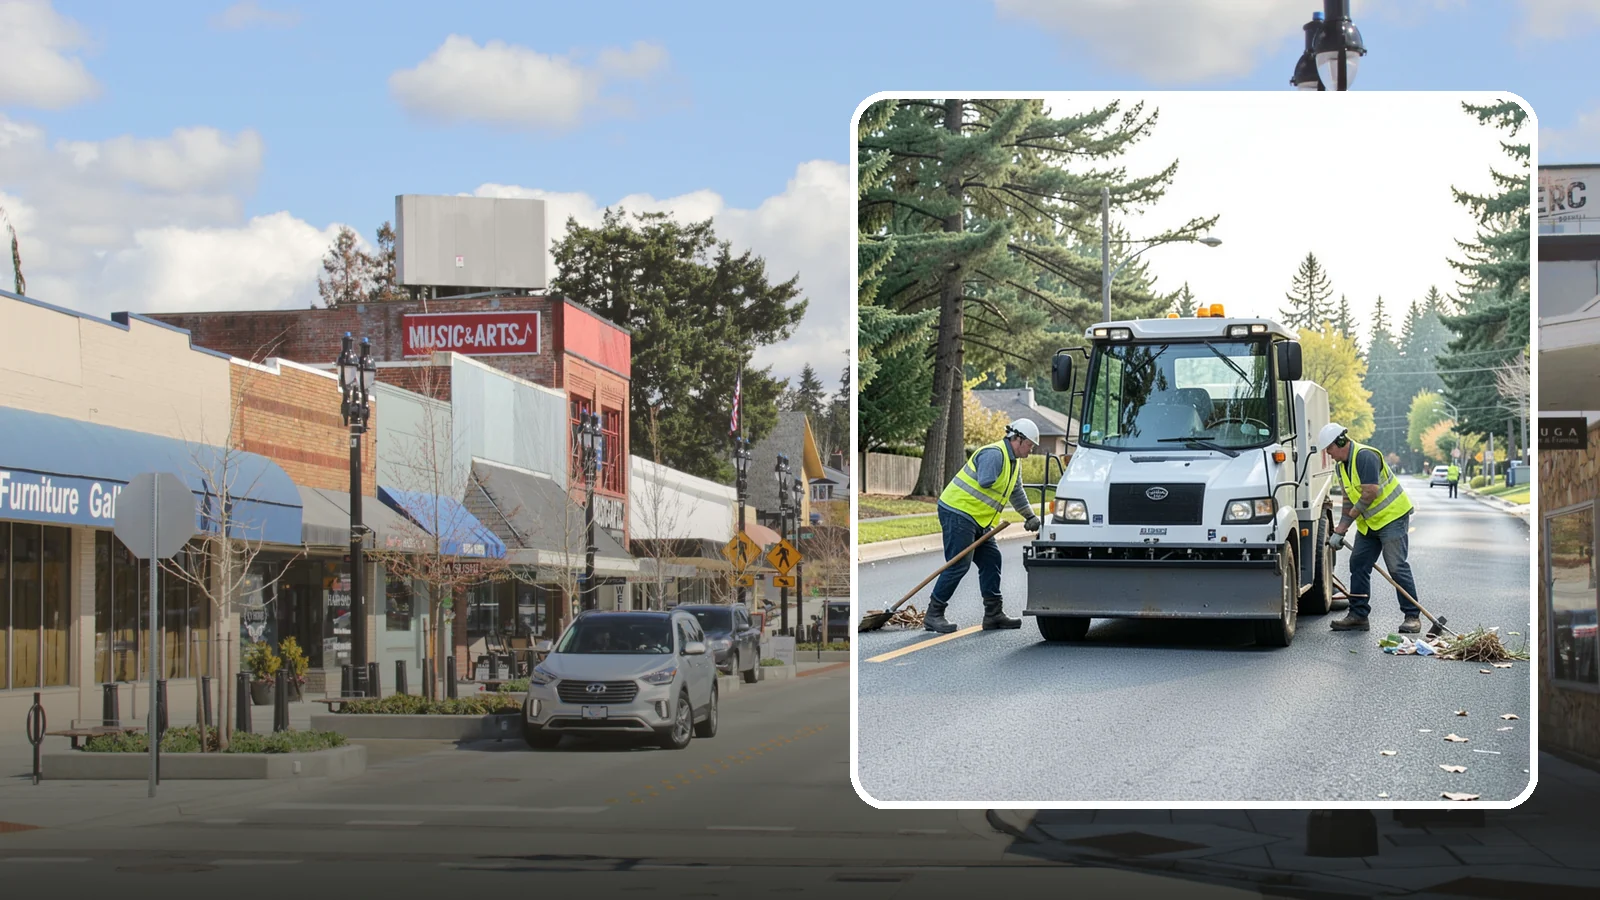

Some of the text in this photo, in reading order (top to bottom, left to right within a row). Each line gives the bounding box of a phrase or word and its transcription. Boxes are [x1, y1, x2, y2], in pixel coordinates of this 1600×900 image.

[409, 322, 519, 349] MUSIC&ARTS
[0, 471, 122, 519] Furniture Gal
